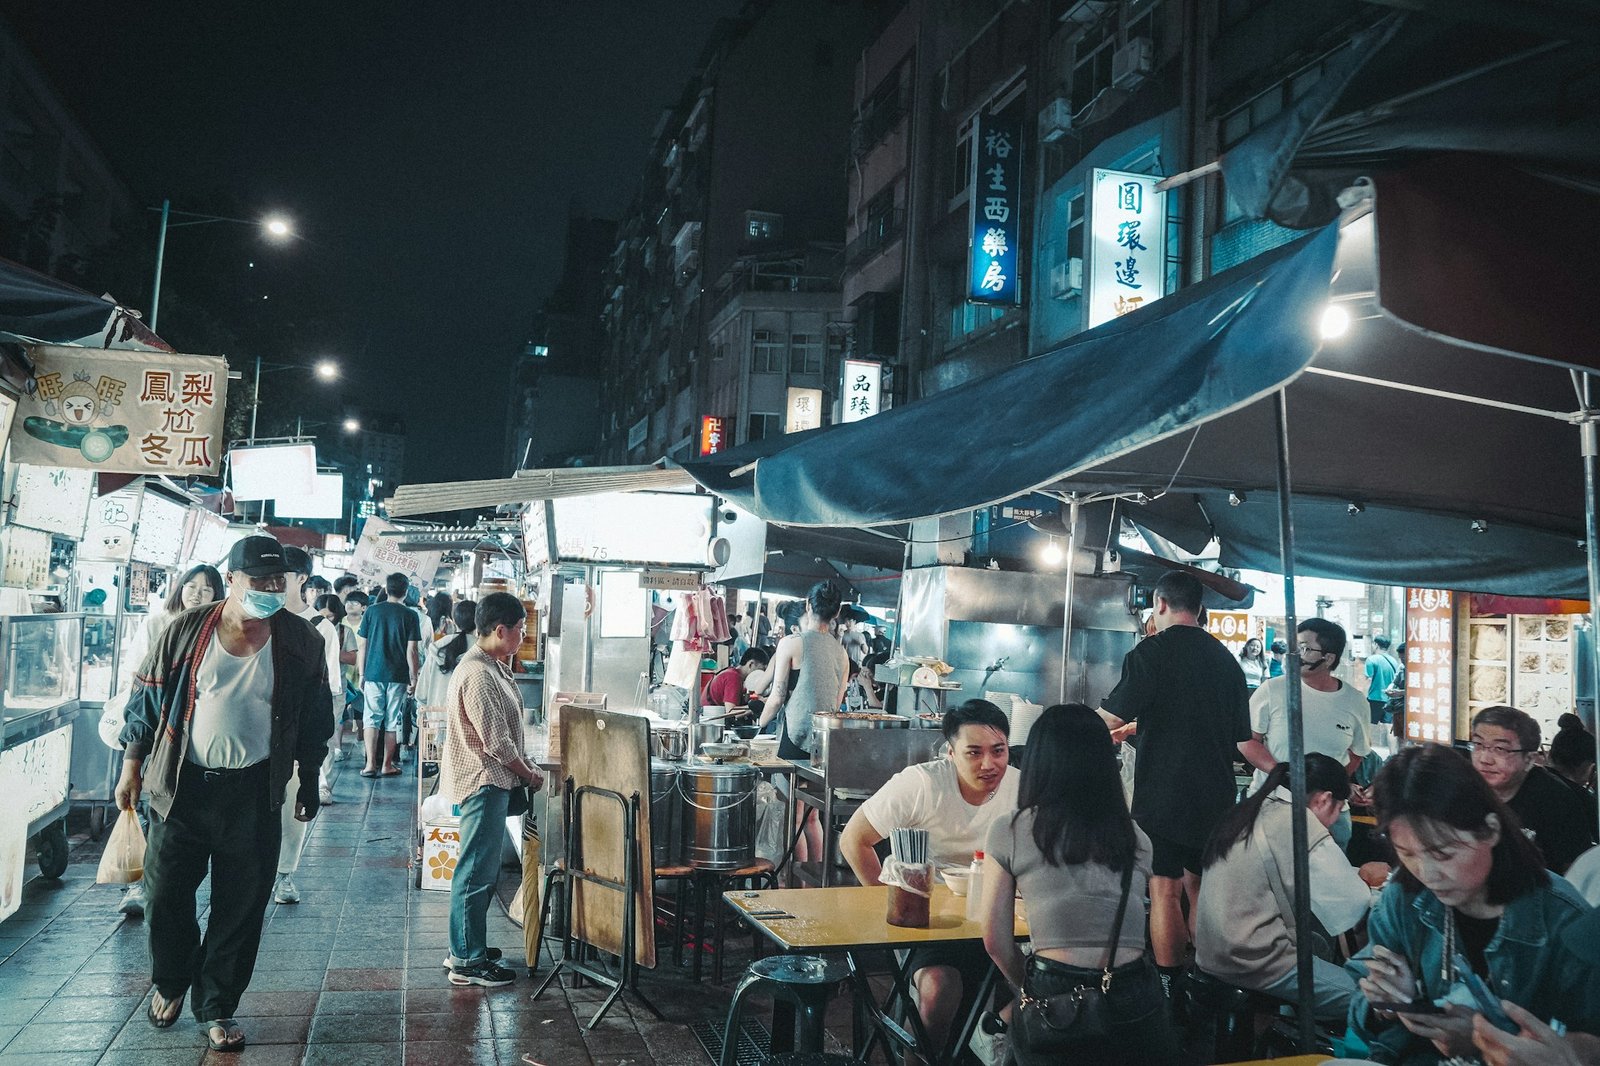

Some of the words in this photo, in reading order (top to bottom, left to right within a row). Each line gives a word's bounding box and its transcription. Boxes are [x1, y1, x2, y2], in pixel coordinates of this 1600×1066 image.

[981, 129, 1013, 292] 裕生西藥房
[37, 372, 63, 401] 旺
[97, 375, 126, 406] 旺
[140, 370, 216, 406] 鳳梨
[161, 407, 195, 434] 尬
[140, 433, 211, 468] 冬瓜
[375, 547, 419, 571] 起司烤餅
[592, 546, 608, 560] 75
